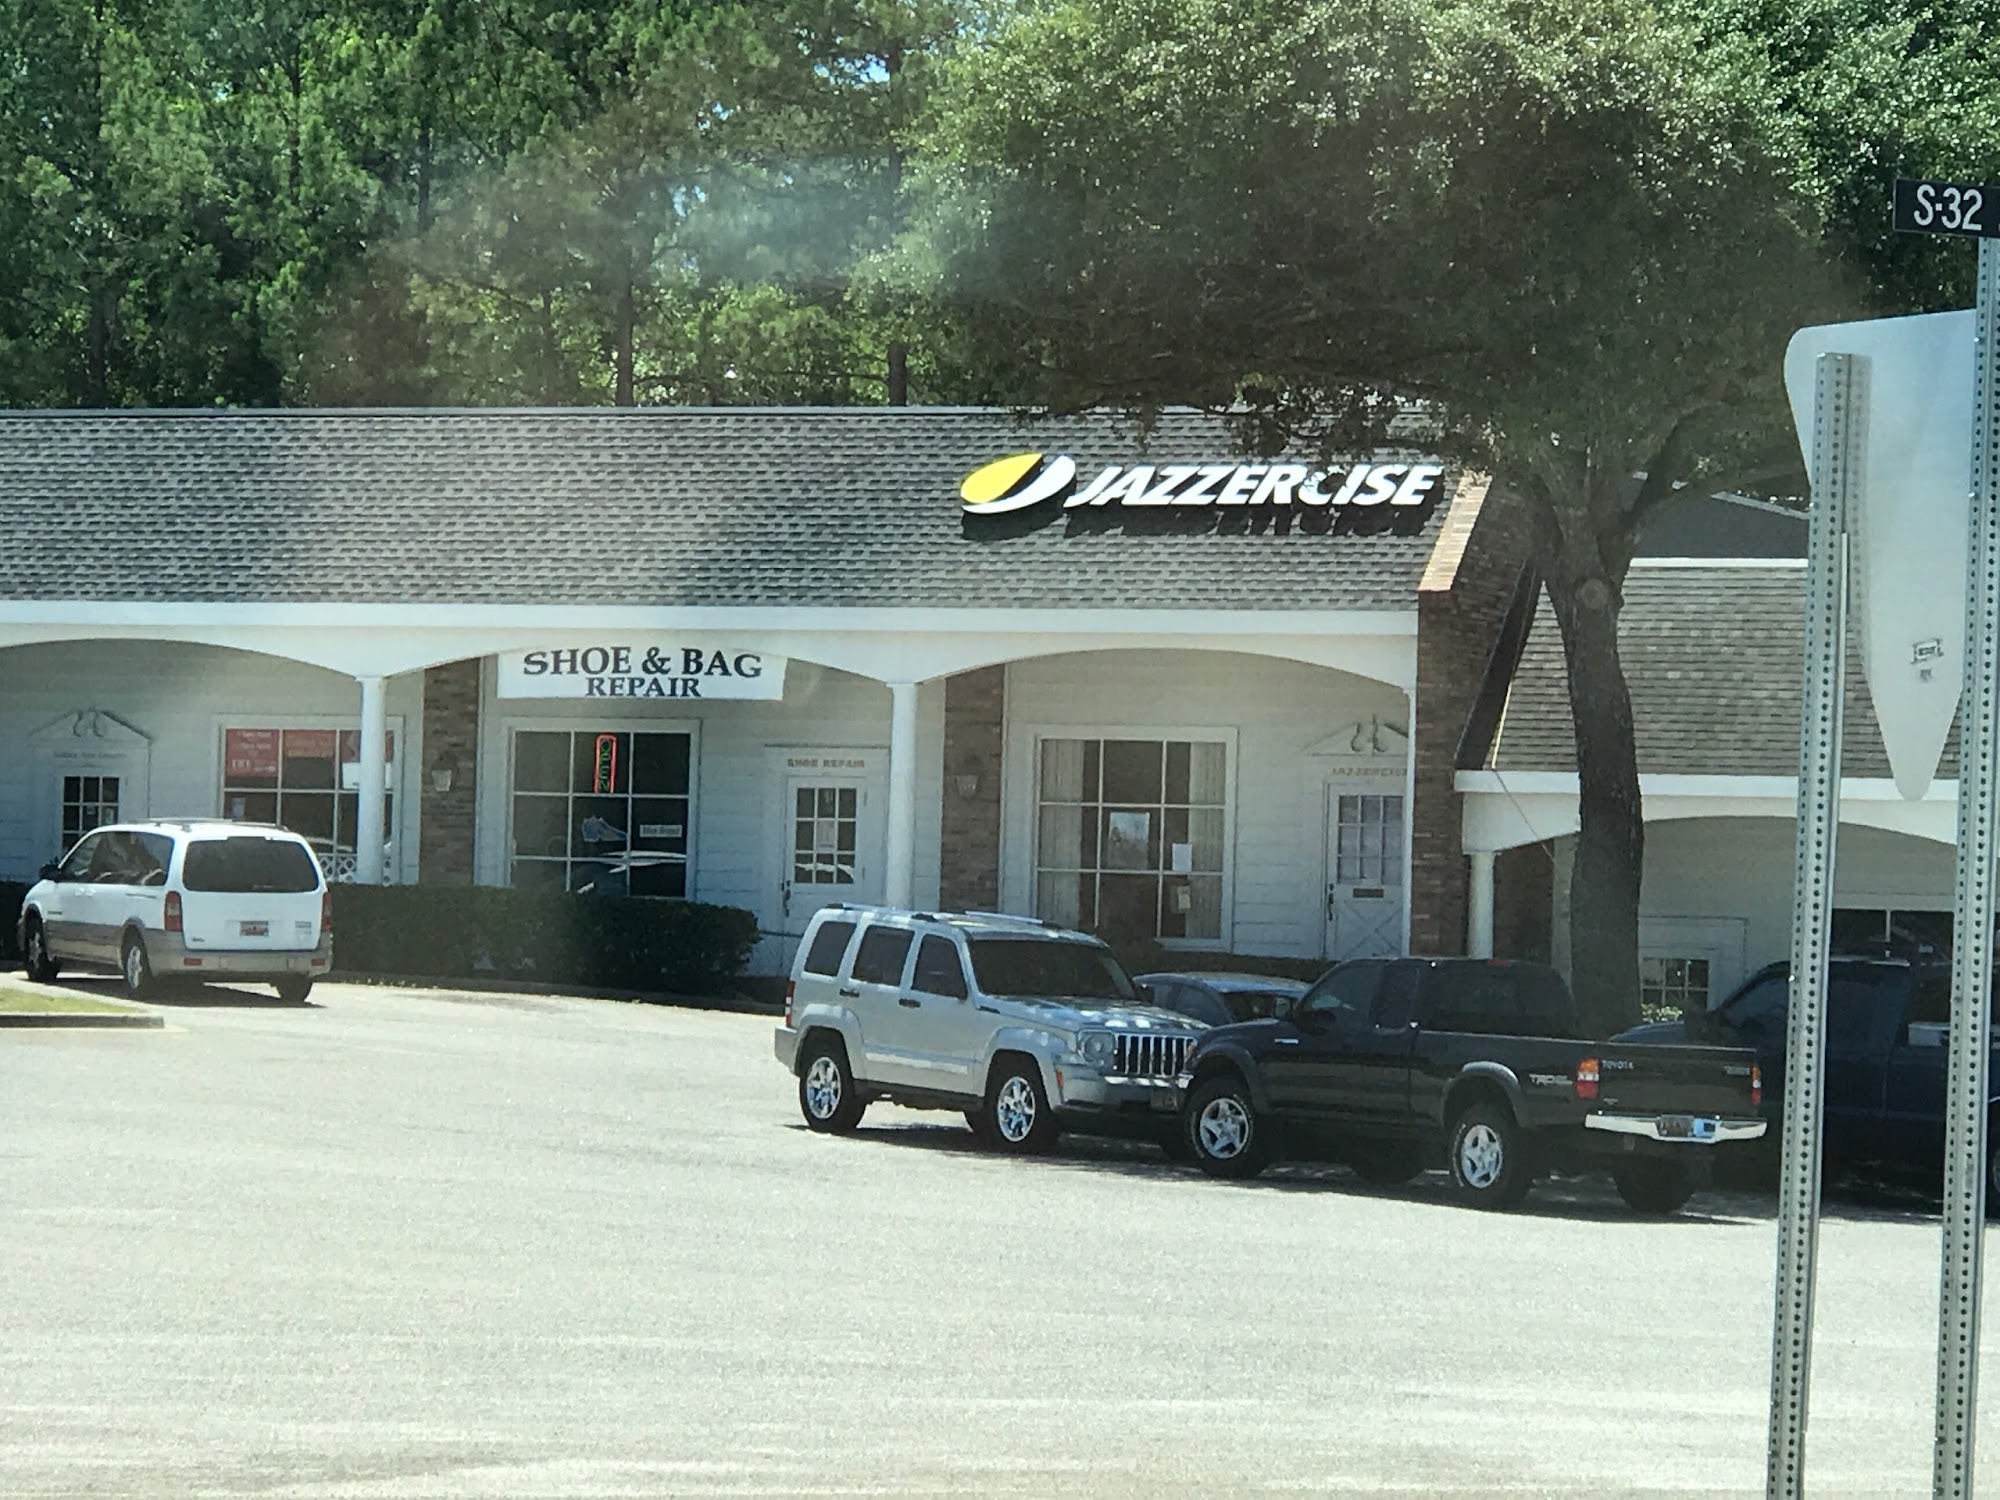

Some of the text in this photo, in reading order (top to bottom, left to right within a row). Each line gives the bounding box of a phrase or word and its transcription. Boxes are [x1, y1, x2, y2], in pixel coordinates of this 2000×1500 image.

[1913, 184, 1983, 231] S-32
[523, 646, 762, 679] SHOE & BAG
[584, 676, 702, 698] REPAIR
[599, 738, 612, 791] OPEN
[787, 758, 865, 768] SHOE REPAIR
[1601, 1059, 1635, 1070] TOYOTA
